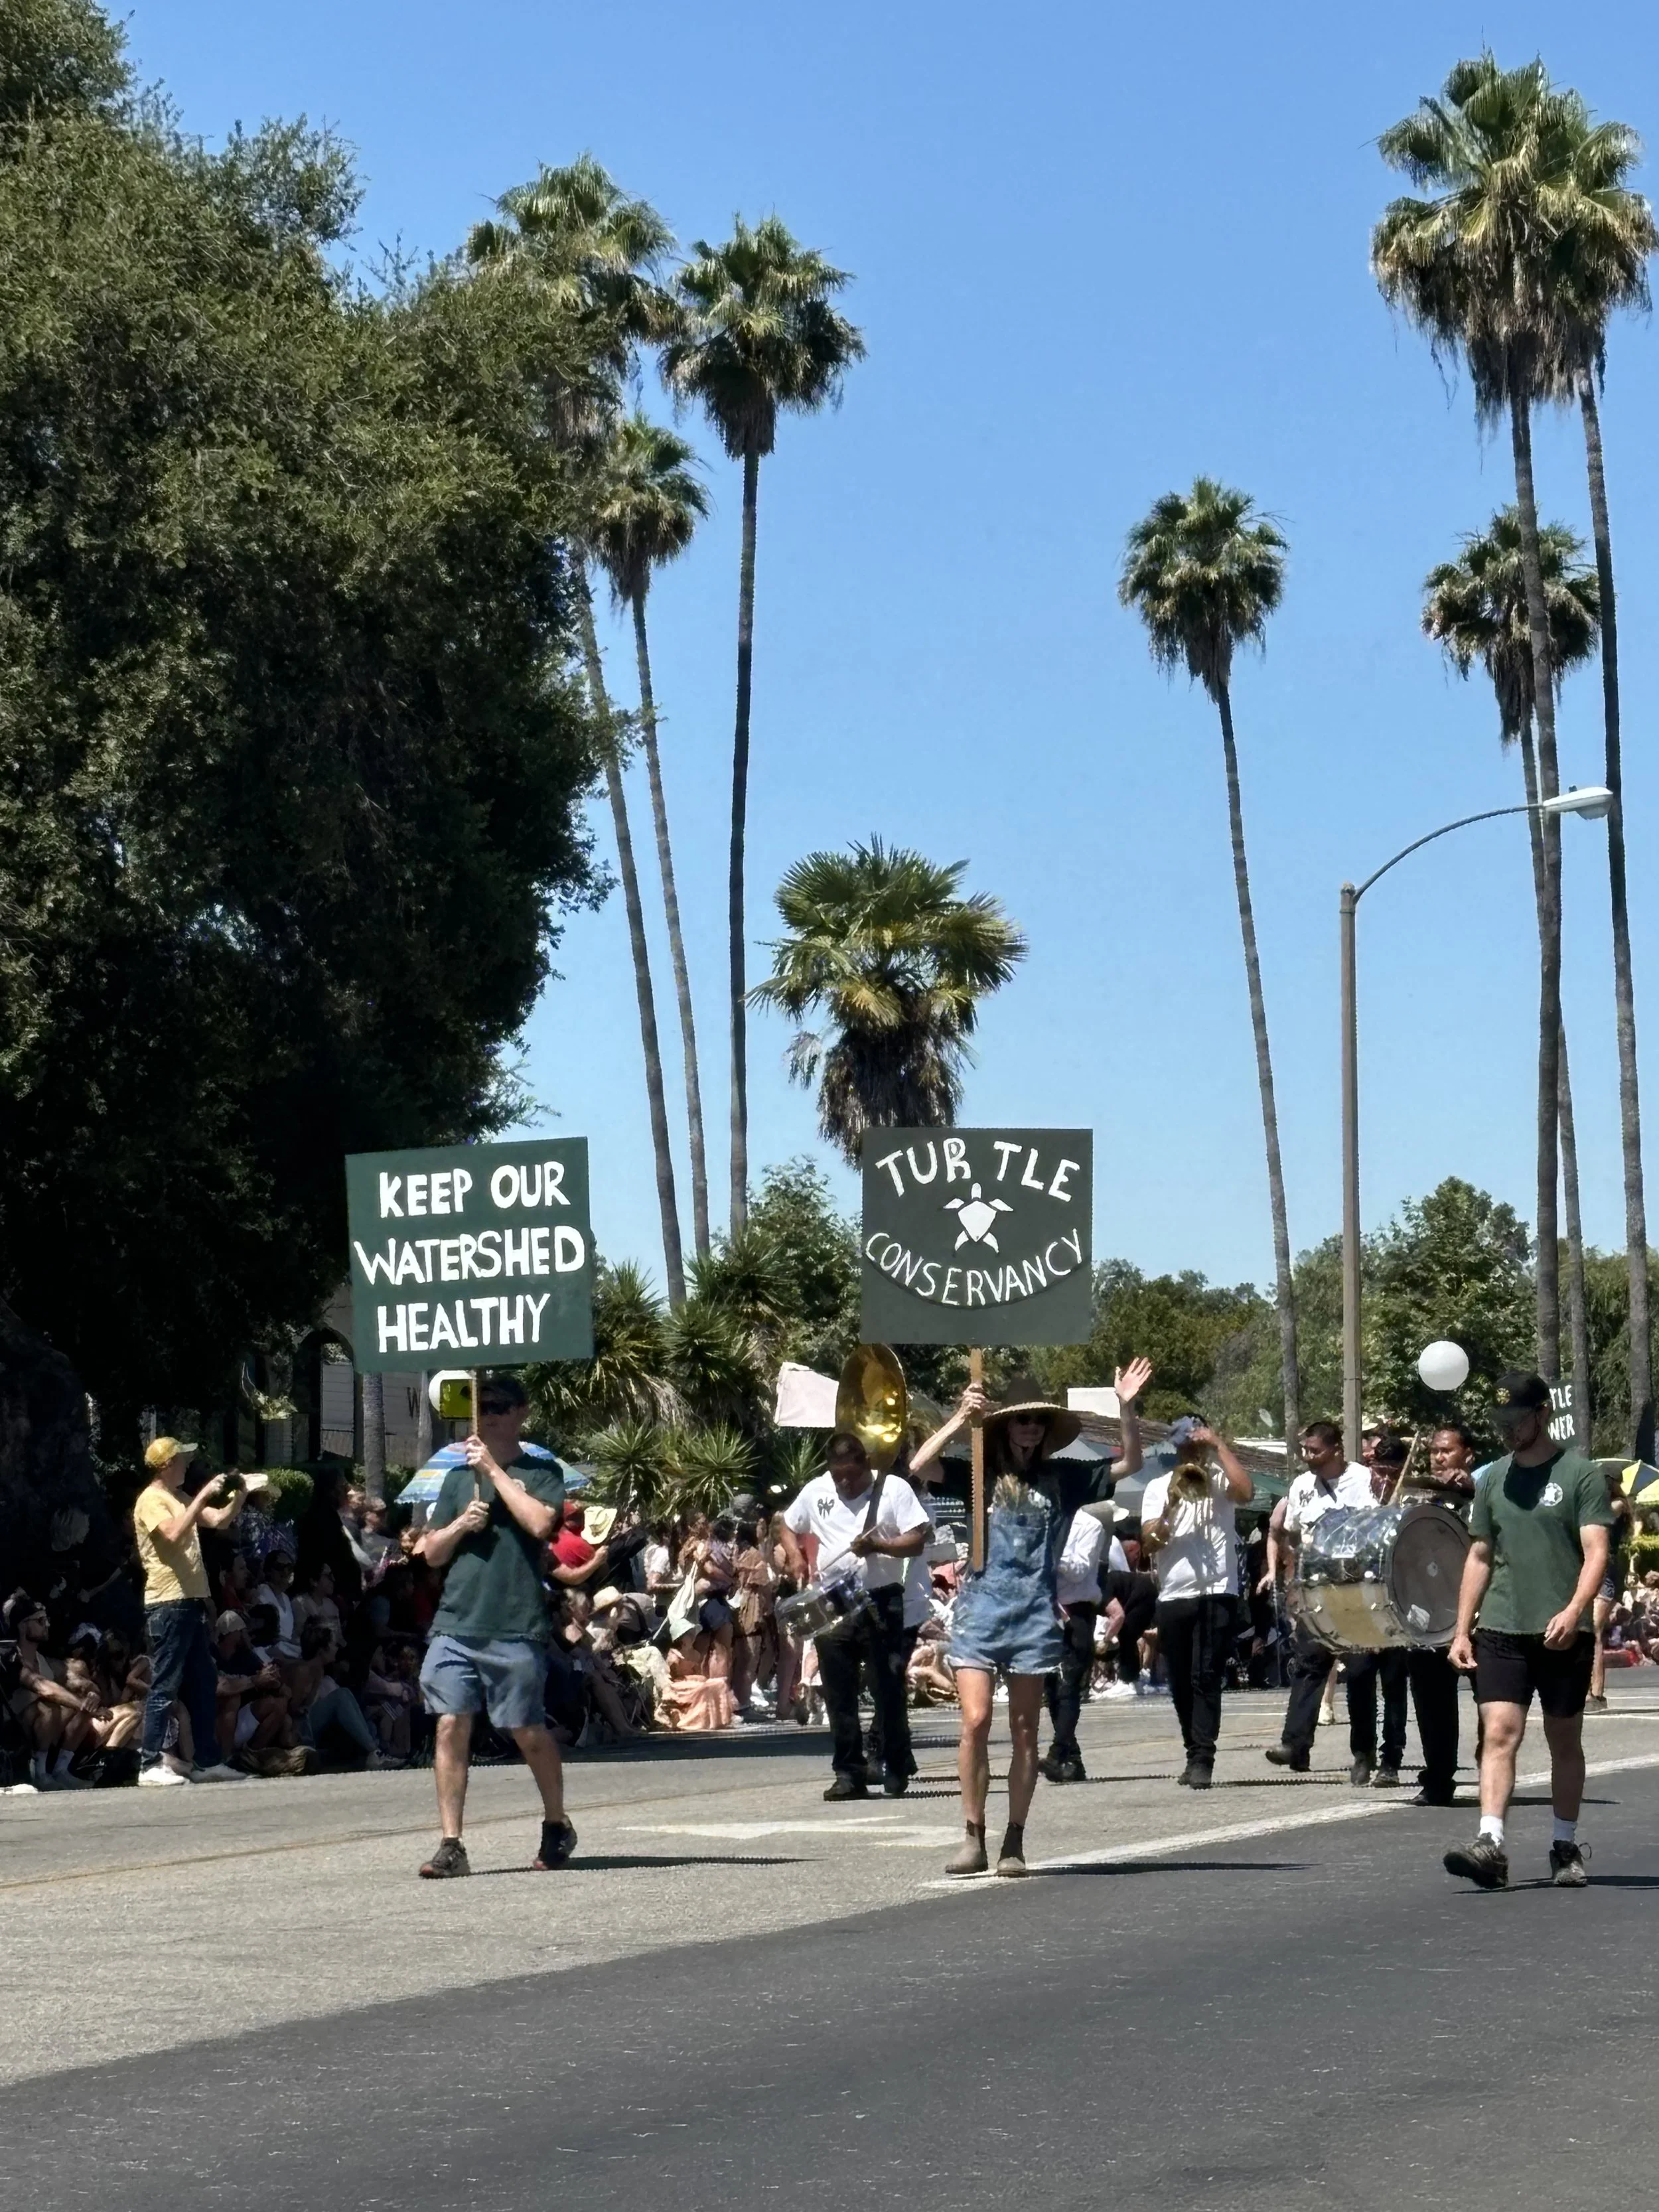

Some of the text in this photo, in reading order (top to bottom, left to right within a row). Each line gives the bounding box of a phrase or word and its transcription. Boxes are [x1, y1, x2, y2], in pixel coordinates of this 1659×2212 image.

[379, 1161, 571, 1218] KEEP OUR
[353, 1225, 585, 1286] WATERSHED
[865, 1228, 1082, 1306] CONSERVANCY
[377, 1293, 551, 1354] HEALTHY
